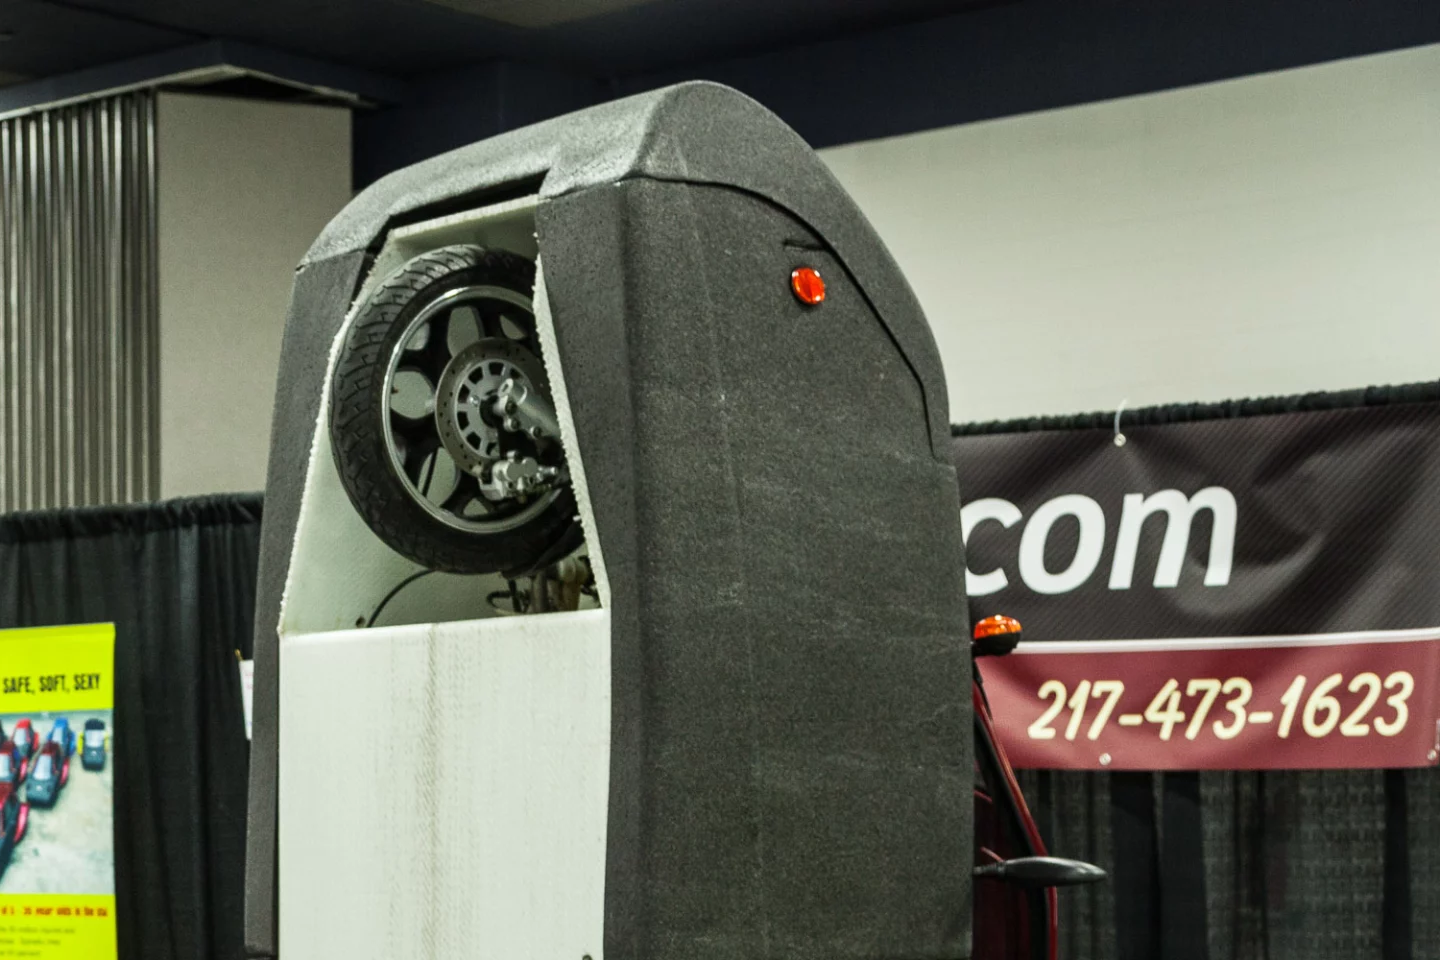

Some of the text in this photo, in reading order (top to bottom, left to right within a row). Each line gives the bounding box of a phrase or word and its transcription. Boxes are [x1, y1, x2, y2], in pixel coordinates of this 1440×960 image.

[3, 676, 36, 695] SAFE,
[40, 674, 71, 694] SOFT,
[73, 672, 101, 691] SEXY
[1027, 671, 1415, 741] 217-473-1623
